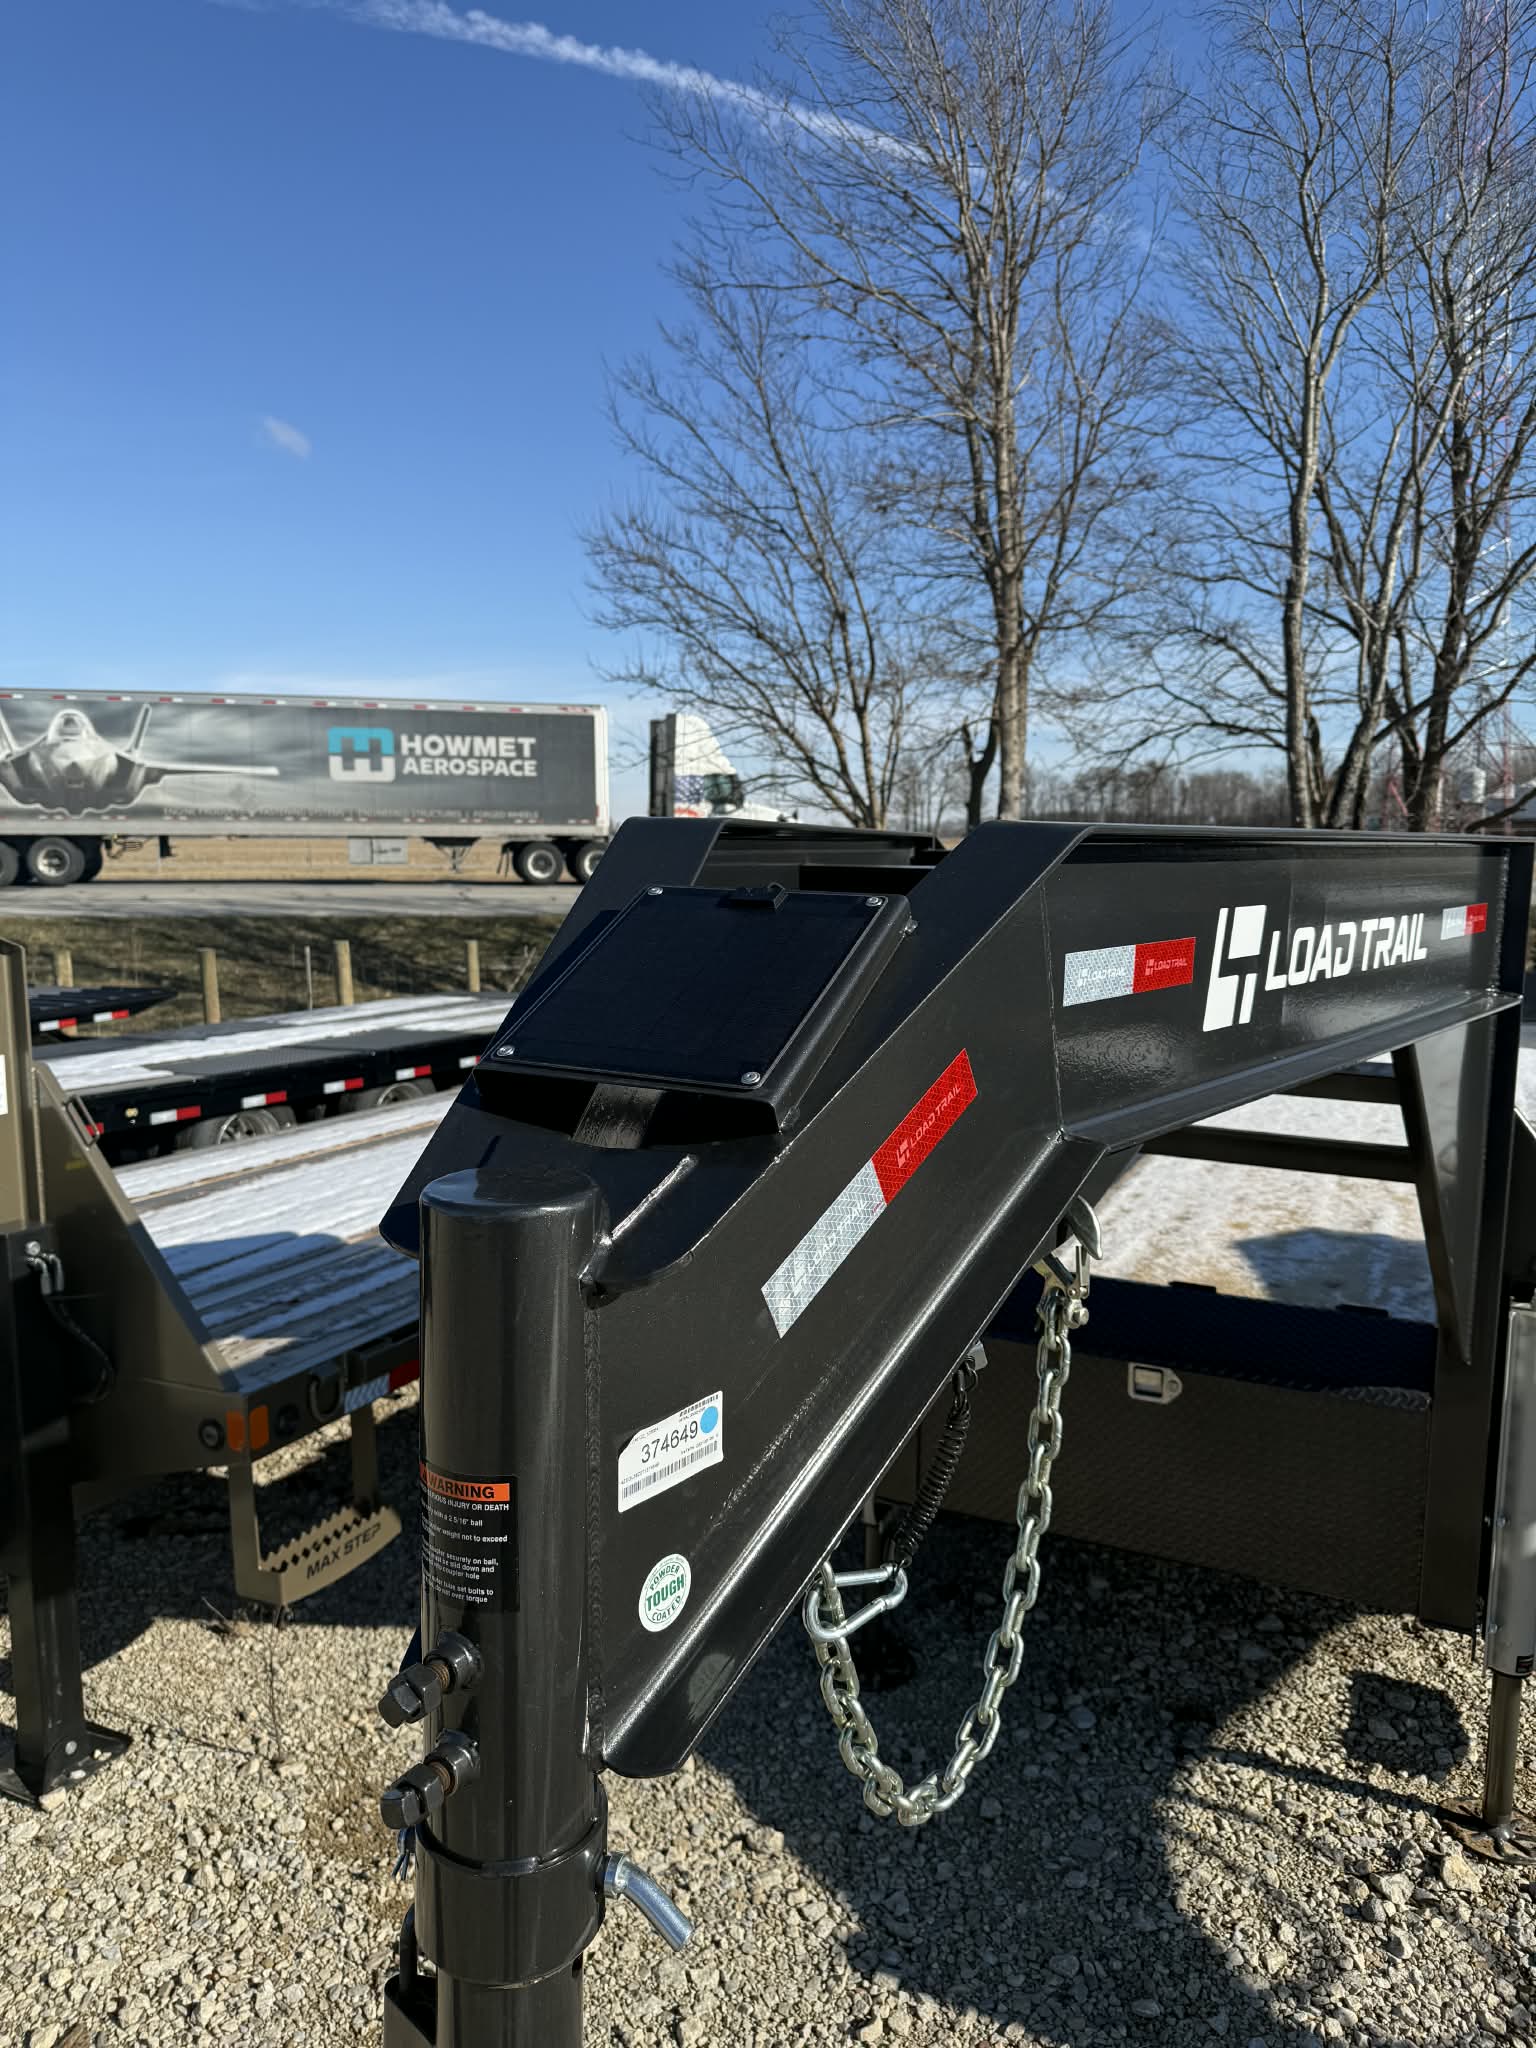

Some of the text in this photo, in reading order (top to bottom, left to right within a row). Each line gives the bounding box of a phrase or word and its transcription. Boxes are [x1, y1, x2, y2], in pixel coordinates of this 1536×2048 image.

[400, 734, 536, 758] HOWMET
[402, 757, 538, 777] AEROSPACE
[641, 1420, 698, 1463] 374649
[428, 1471, 495, 1499] WARNING
[447, 1498, 470, 1510] INJURY
[472, 1503, 483, 1511] OR
[484, 1503, 510, 1511] DEATH
[470, 1519, 483, 1527] ball
[461, 1533, 473, 1541] not
[306, 1522, 382, 1579] MAX STEP
[462, 1563, 480, 1572] down
[483, 1558, 499, 1567] ball,
[465, 1572, 480, 1580] hole
[650, 1564, 680, 1591] POWDER
[465, 1593, 488, 1604] torque
[468, 1587, 486, 1595] bolts
[646, 1574, 685, 1611] TOUGH
[652, 1595, 681, 1621] COATED
